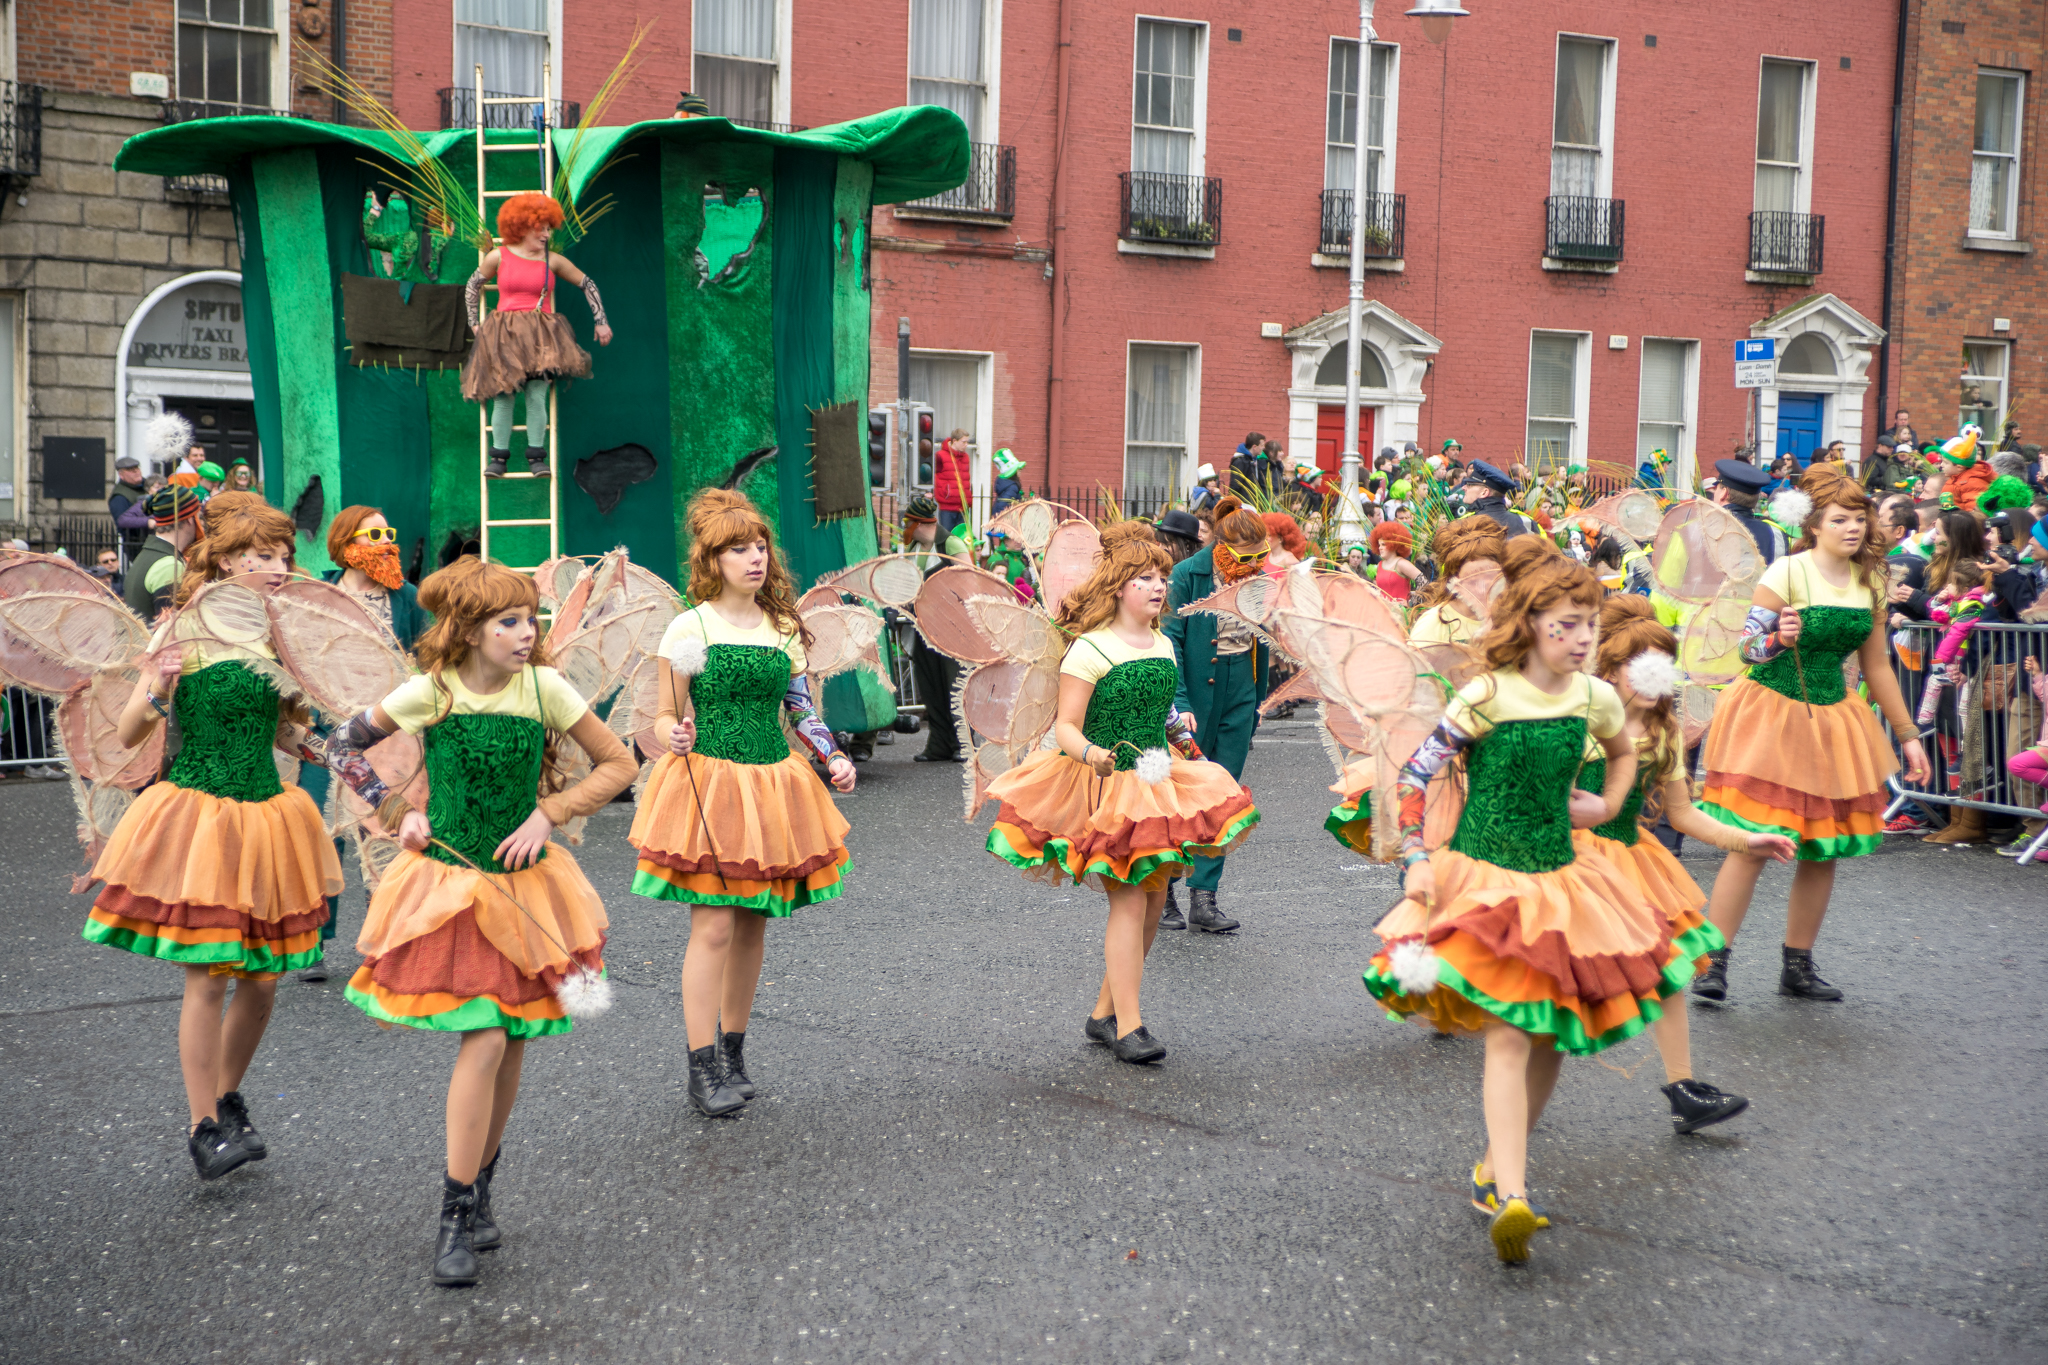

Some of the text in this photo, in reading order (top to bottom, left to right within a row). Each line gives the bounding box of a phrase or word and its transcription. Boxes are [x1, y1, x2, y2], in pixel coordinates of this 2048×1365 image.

[186, 299, 241, 322] SIPTU
[192, 326, 234, 343] TAXI
[134, 342, 212, 362] DRIVERS
